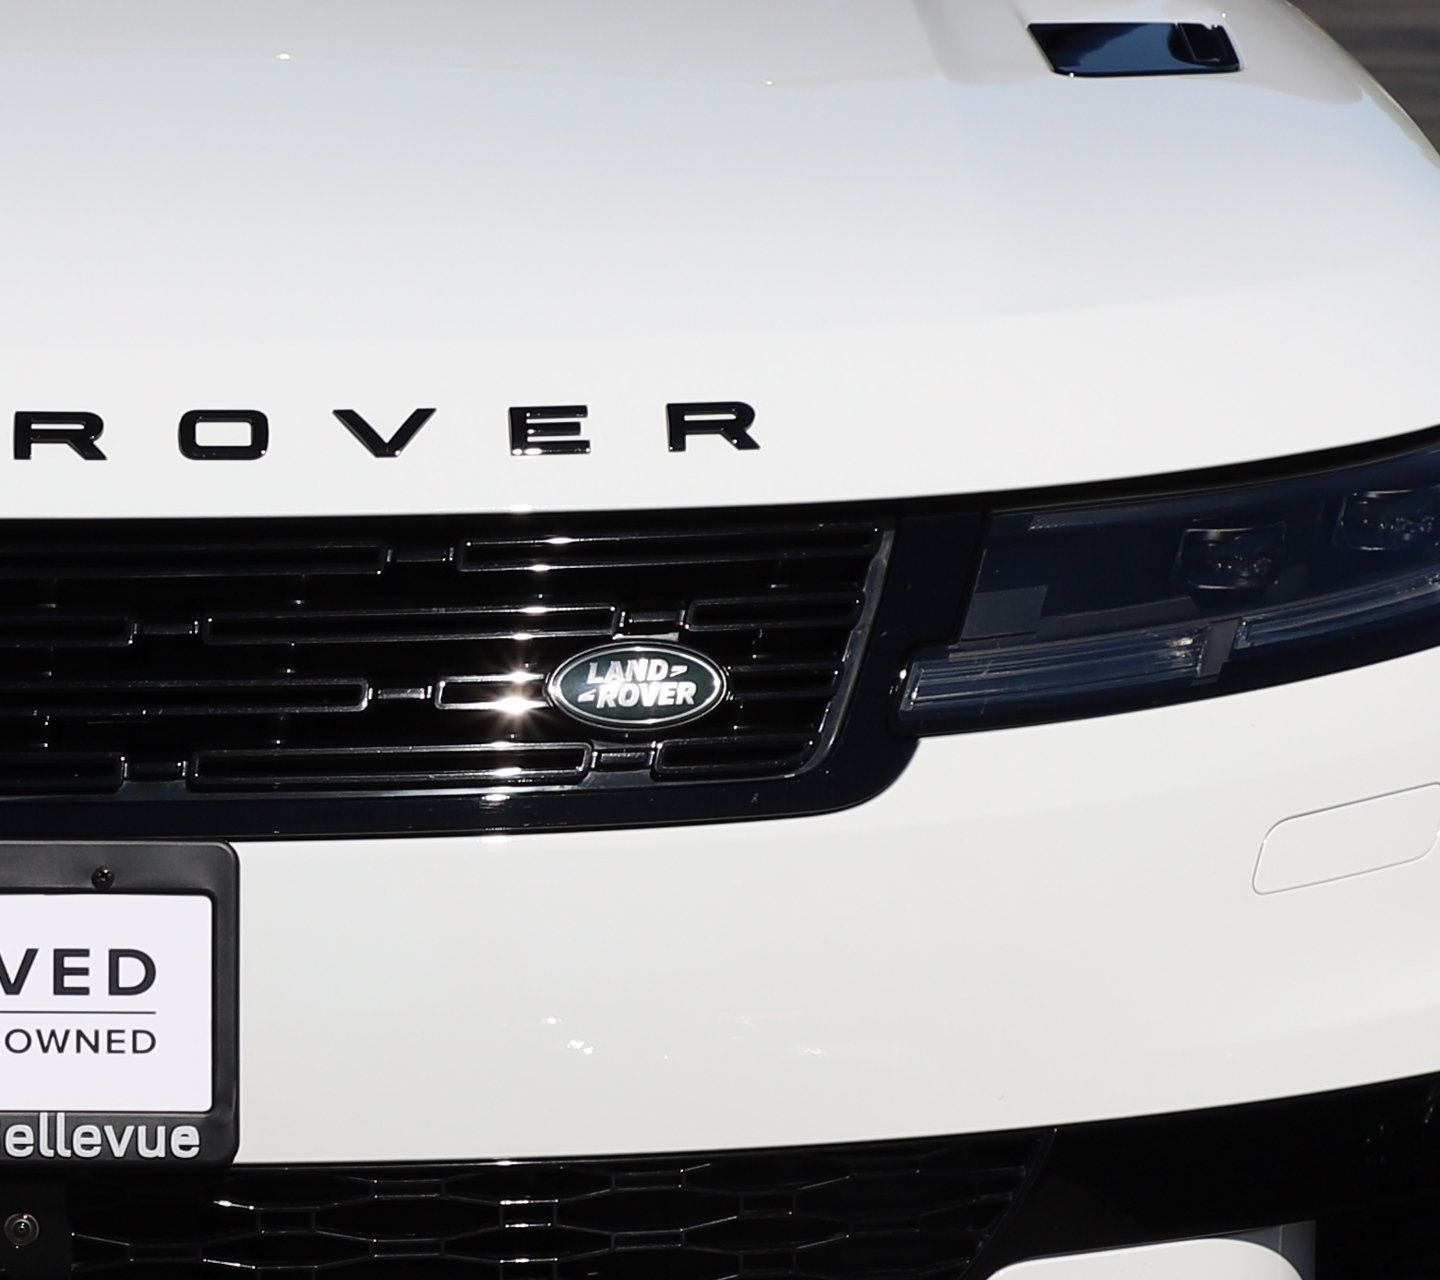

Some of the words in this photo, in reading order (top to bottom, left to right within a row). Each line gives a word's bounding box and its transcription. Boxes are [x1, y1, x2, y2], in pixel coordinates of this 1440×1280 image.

[13, 401, 761, 461] ROVER
[586, 658, 668, 685] LAND
[596, 681, 697, 709] ROVER
